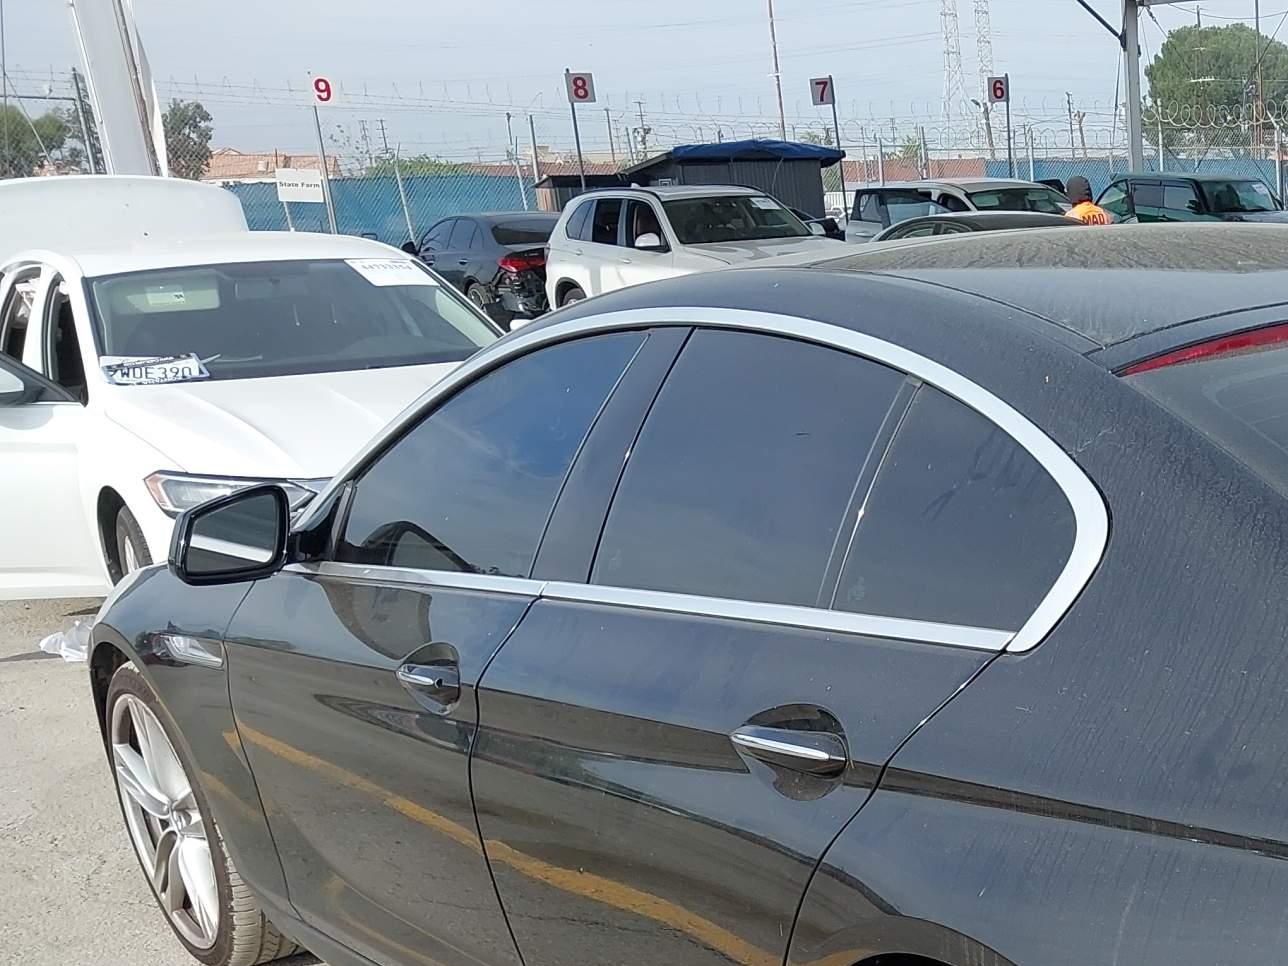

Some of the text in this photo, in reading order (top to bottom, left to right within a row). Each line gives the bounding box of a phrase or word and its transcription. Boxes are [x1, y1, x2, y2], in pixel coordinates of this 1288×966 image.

[313, 78, 332, 102] 9
[572, 76, 590, 100] 8
[814, 80, 829, 102] 7
[992, 79, 1005, 100] 6
